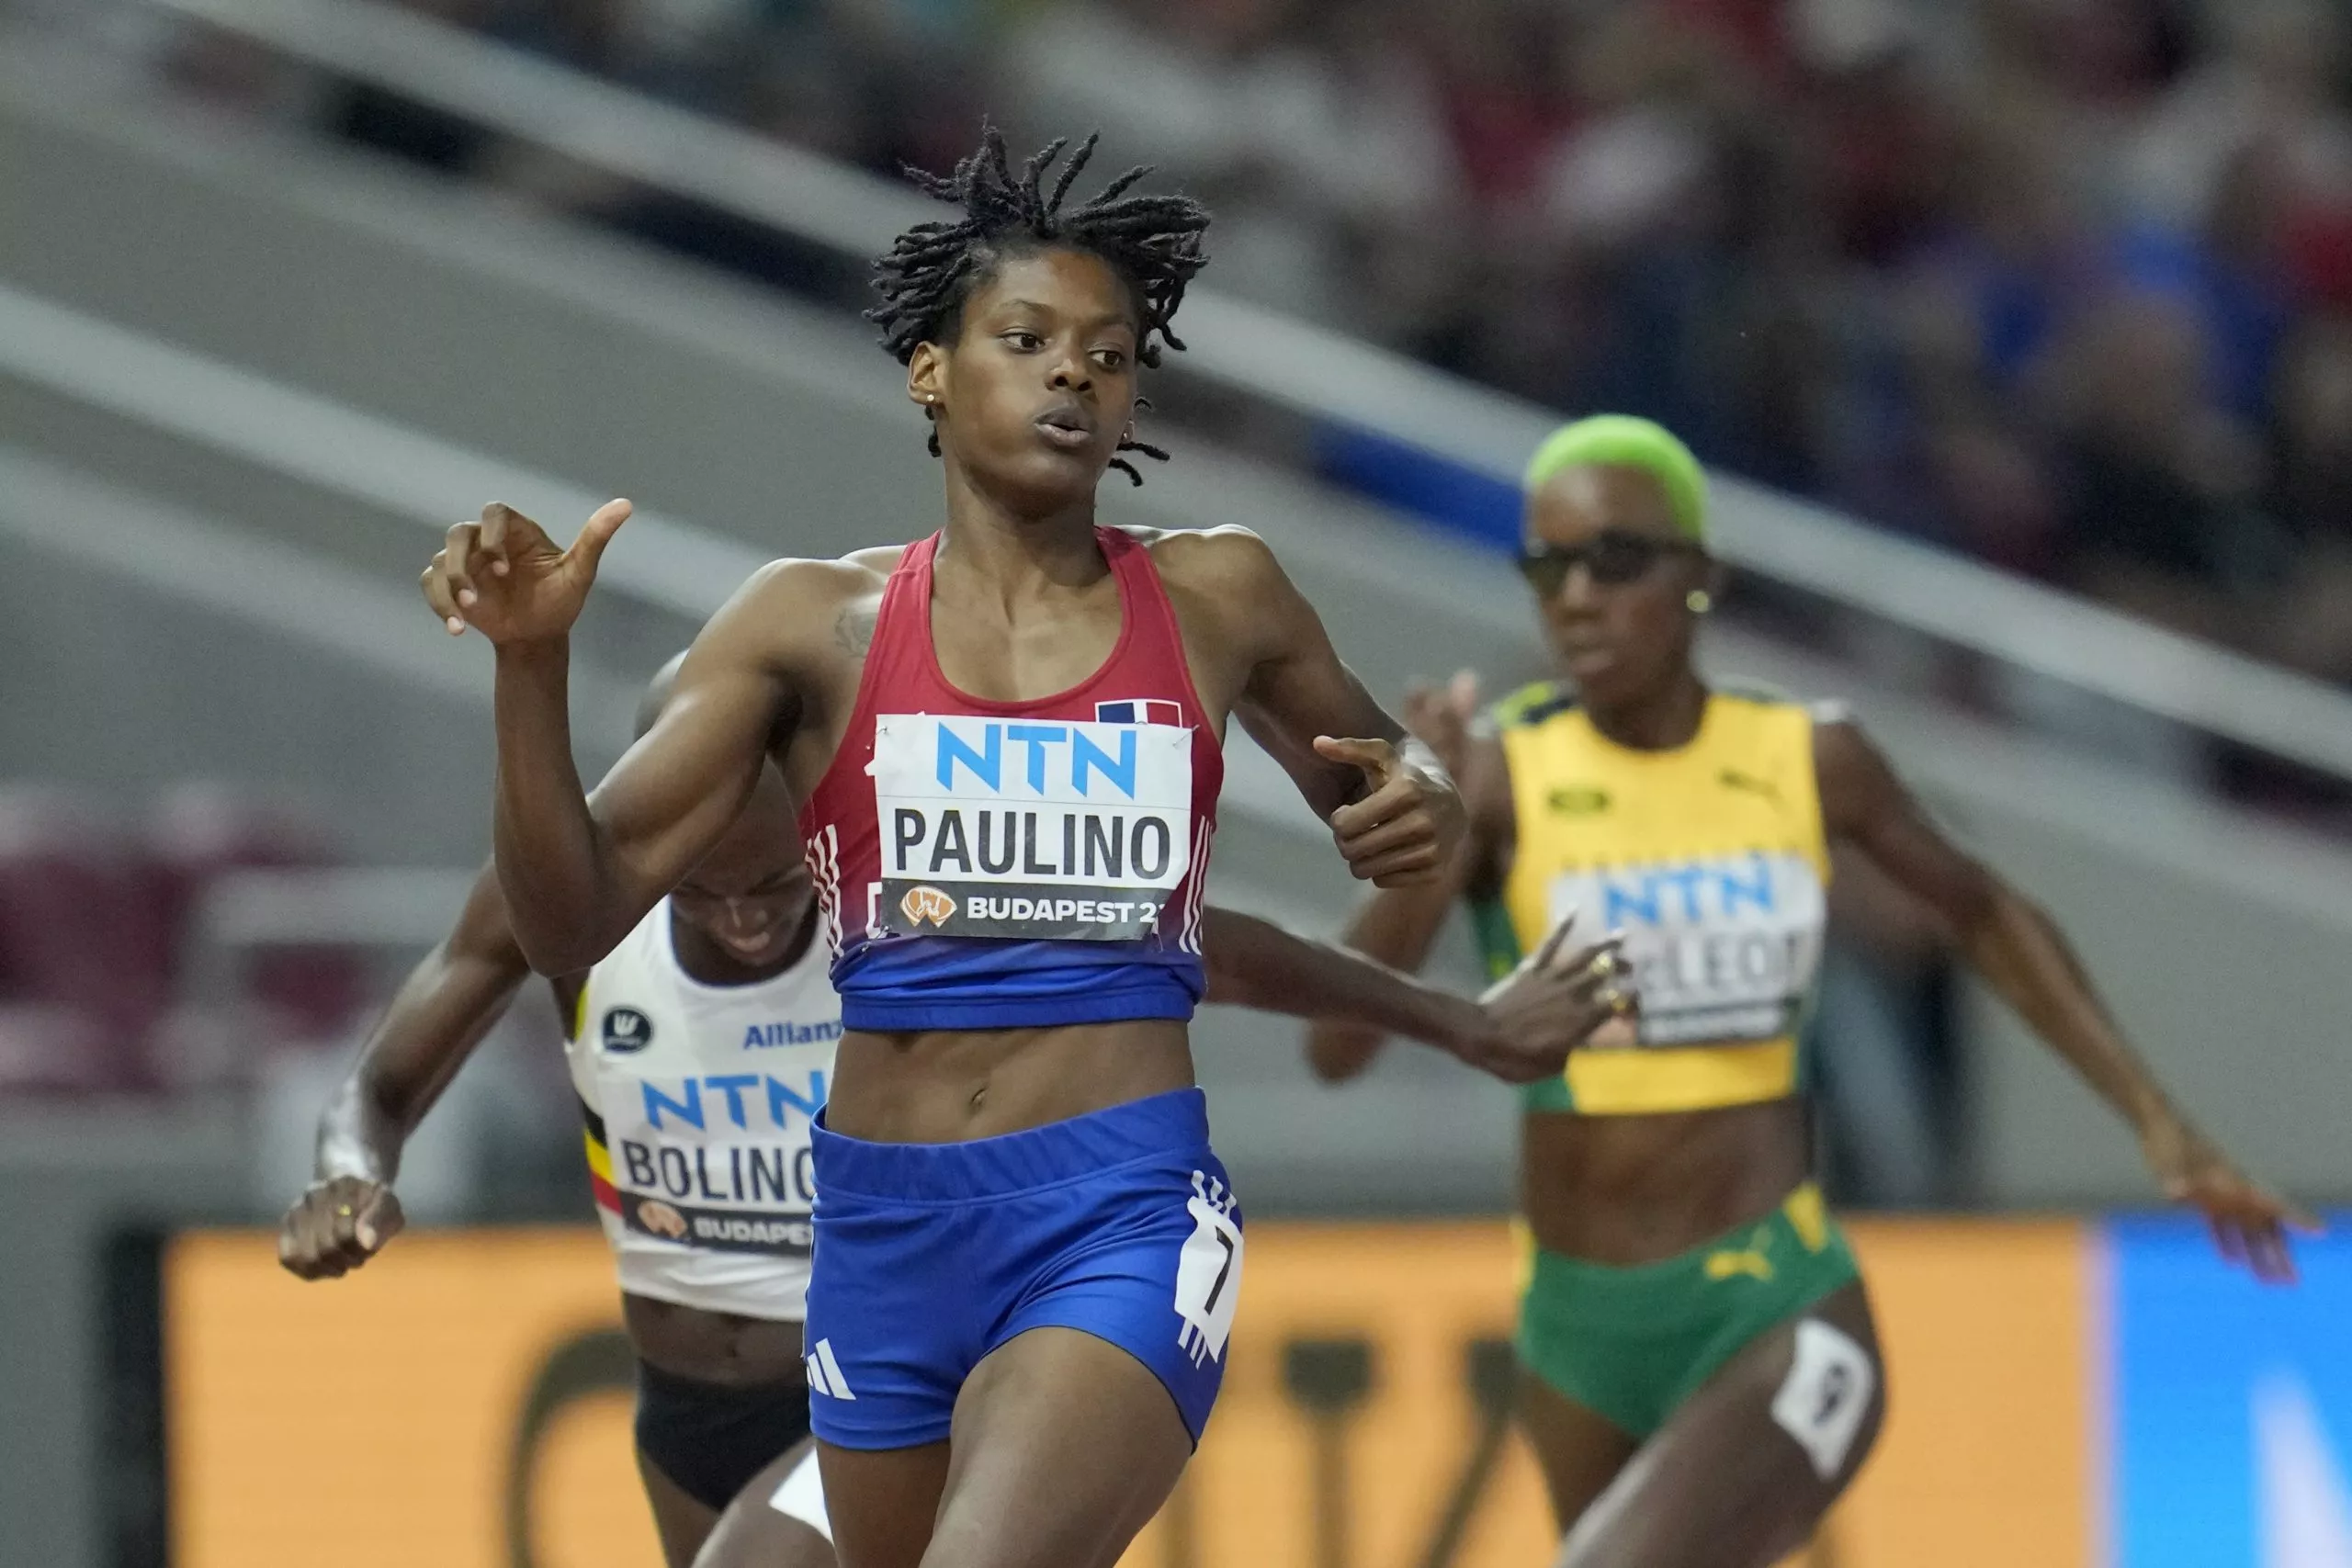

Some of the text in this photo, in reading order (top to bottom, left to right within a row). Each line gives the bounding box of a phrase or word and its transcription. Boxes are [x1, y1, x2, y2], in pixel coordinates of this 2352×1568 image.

[936, 721, 1136, 800] NTN
[894, 807, 1170, 879] PAULINO
[967, 897, 1165, 923] BUDAPEST 2
[1603, 850, 1774, 931] NTN
[641, 1070, 827, 1132] NTN
[695, 1216, 812, 1246] BUDAPE
[1203, 1225, 1235, 1316] 7
